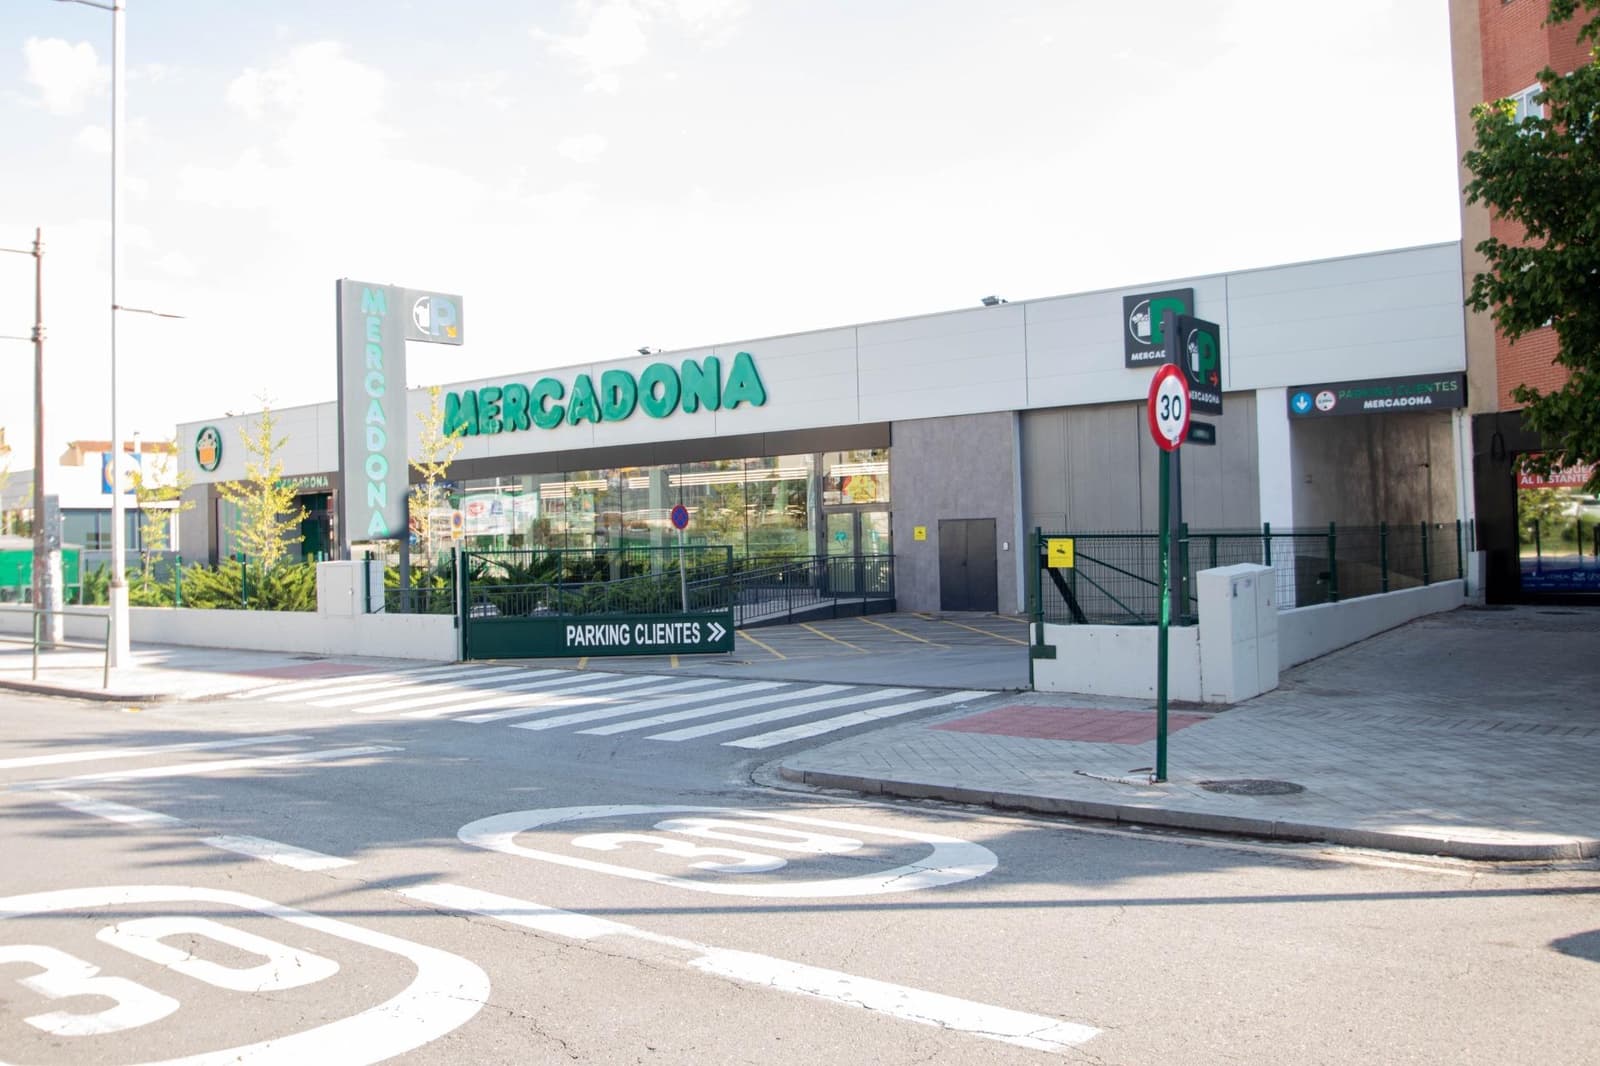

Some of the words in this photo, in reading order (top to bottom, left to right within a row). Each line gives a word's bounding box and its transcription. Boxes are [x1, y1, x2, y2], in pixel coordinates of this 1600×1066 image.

[443, 352, 766, 437] MERCADONA
[1190, 390, 1220, 404] ERCADONA
[1397, 380, 1458, 395] CLIENTES
[361, 288, 390, 538] MERCADONA
[1160, 394, 1182, 421] 30
[1363, 395, 1432, 409] MERCADONA
[1521, 476, 1534, 485] AL
[566, 624, 630, 646] PARKING
[635, 622, 701, 644] CLIENTES
[570, 818, 864, 873] 30
[0, 916, 340, 1036] 30
